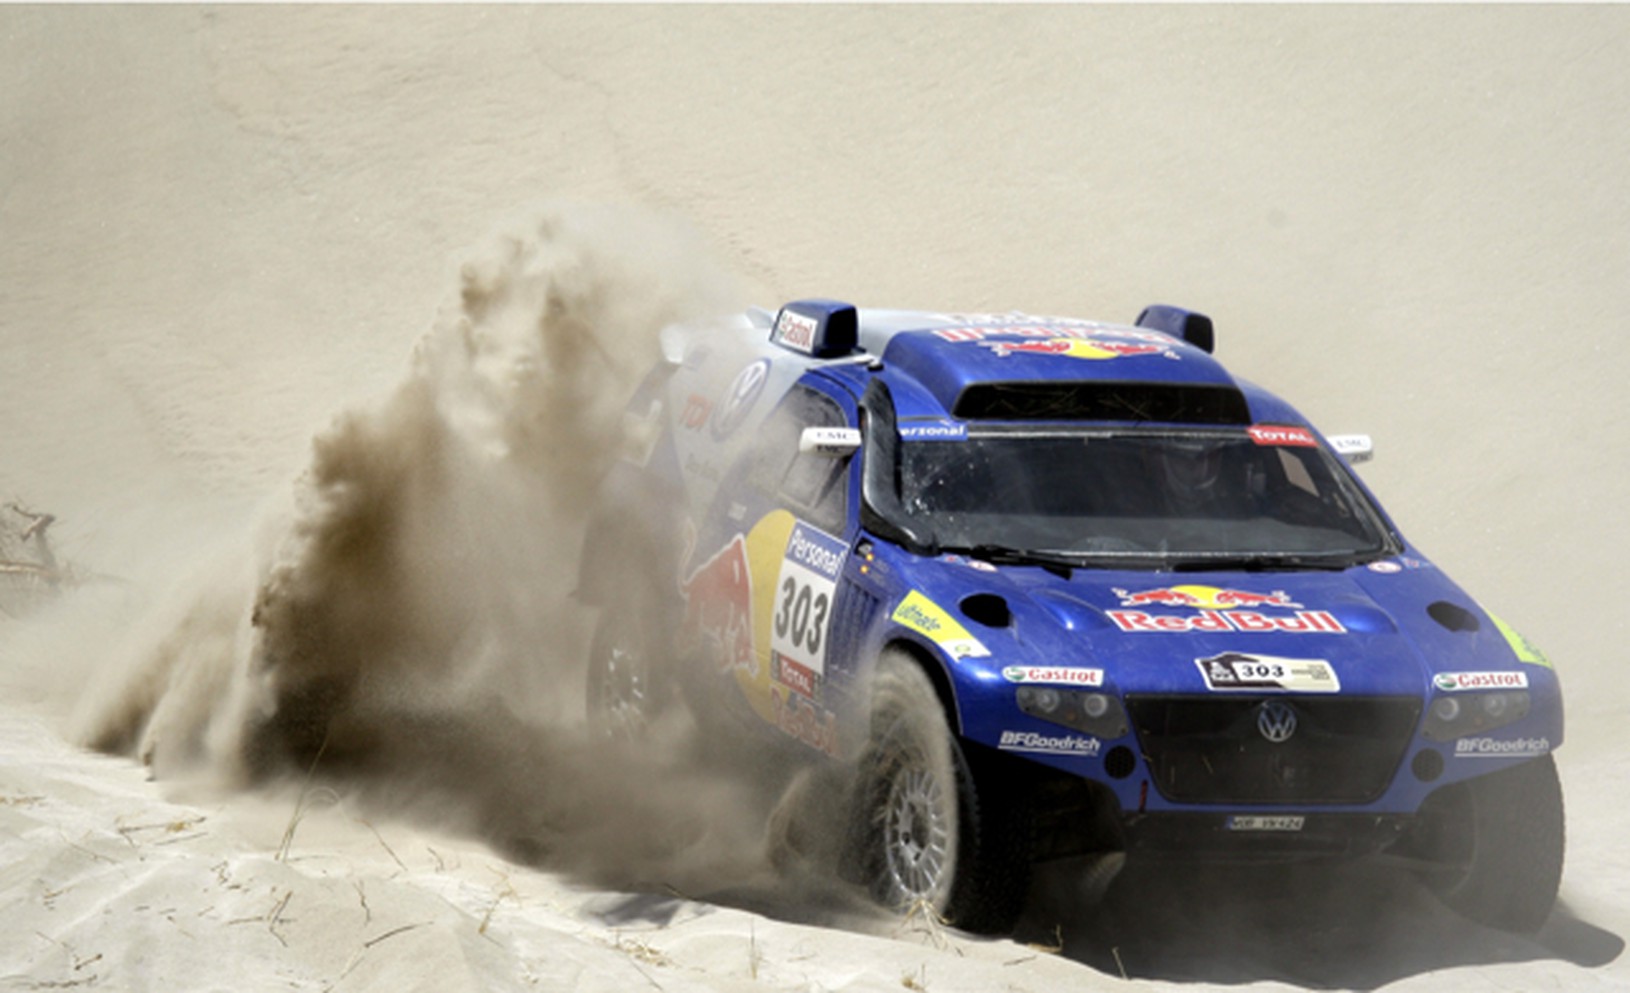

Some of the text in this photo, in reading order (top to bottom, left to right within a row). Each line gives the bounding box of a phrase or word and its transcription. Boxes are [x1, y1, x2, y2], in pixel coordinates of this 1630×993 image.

[899, 425, 965, 436] ersonal
[1251, 428, 1313, 443] TOTAL
[791, 527, 847, 577] Personal
[775, 576, 829, 656] 303
[780, 657, 812, 694] TOTAL
[1029, 668, 1098, 683] Castrol
[1242, 664, 1285, 678] 303
[1458, 672, 1523, 688] Castrol
[1000, 730, 1100, 751] BFGoodrich
[1456, 738, 1550, 752] BFGoodrich
